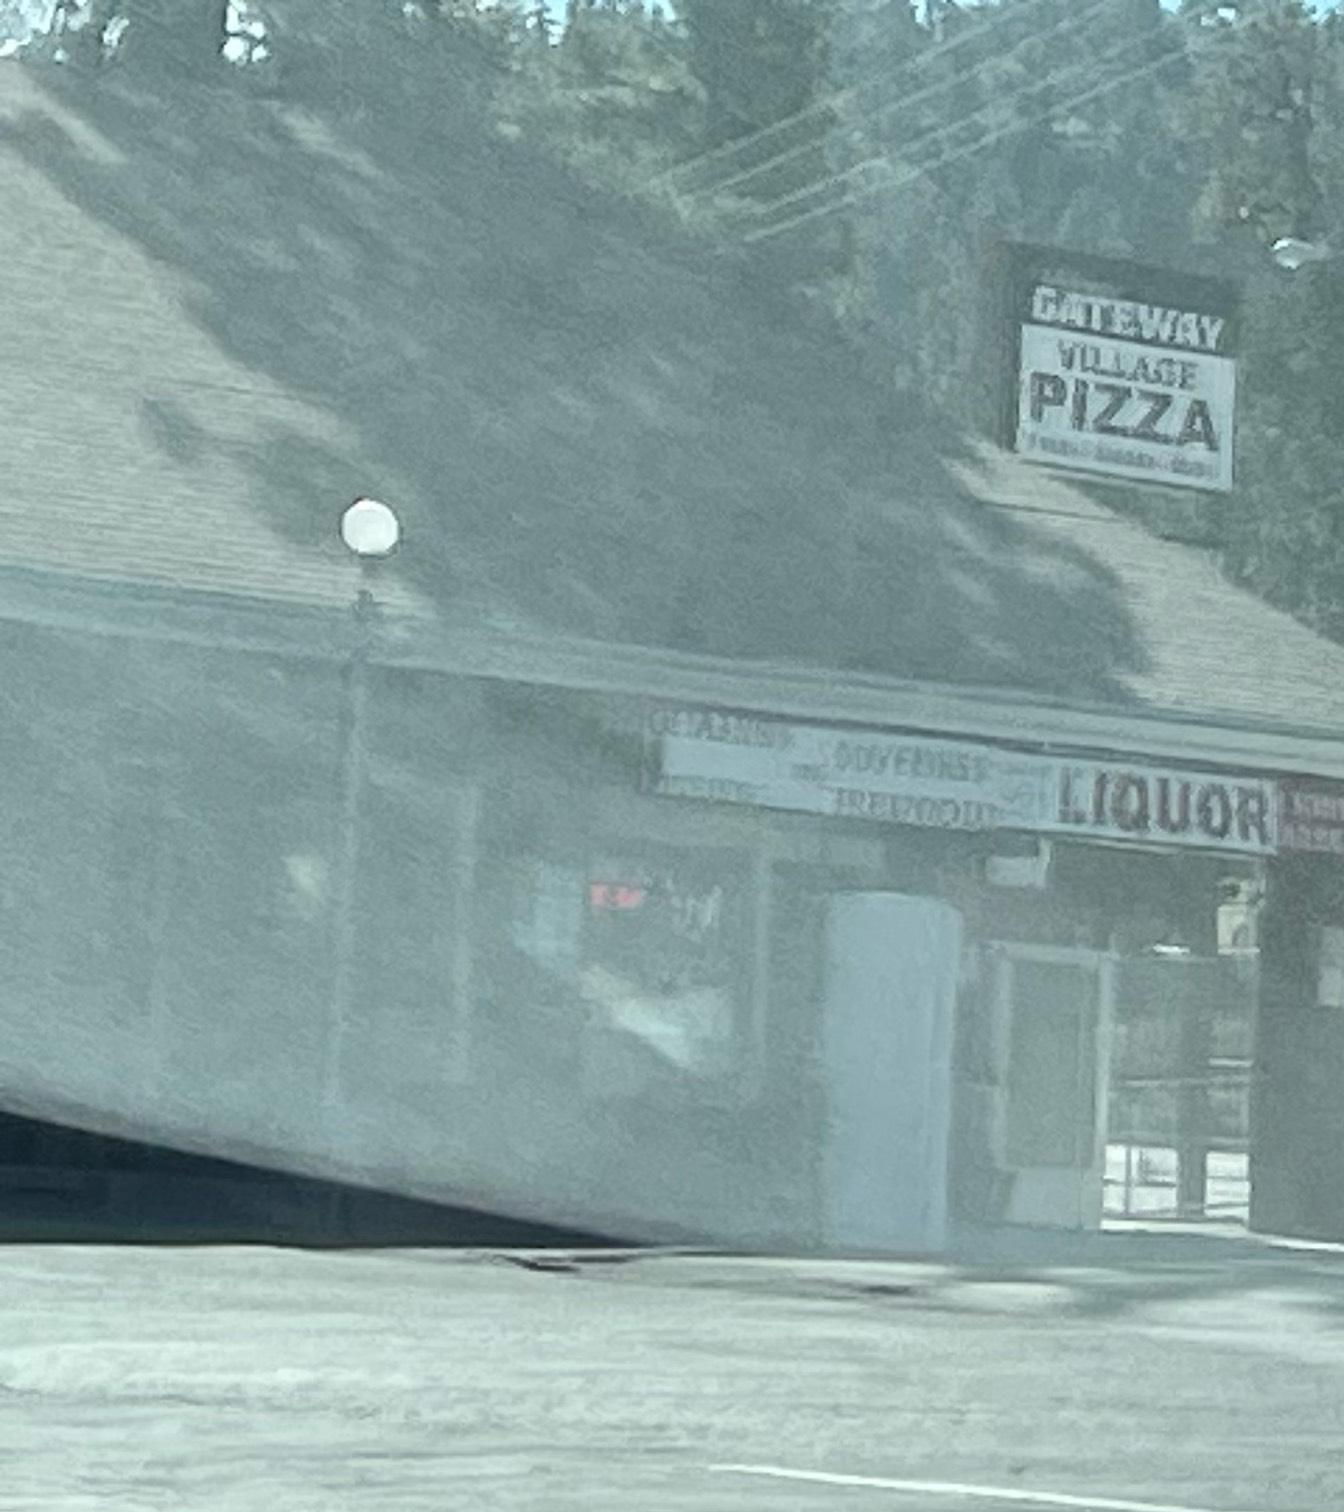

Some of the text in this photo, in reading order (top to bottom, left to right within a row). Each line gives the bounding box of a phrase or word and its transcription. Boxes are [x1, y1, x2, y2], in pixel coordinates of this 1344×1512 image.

[1031, 285, 1224, 350] GATEWAY
[1057, 339, 1200, 389] VILLAGE
[1029, 371, 1219, 452] PIZZA
[1056, 766, 1270, 846] LIQUOR
